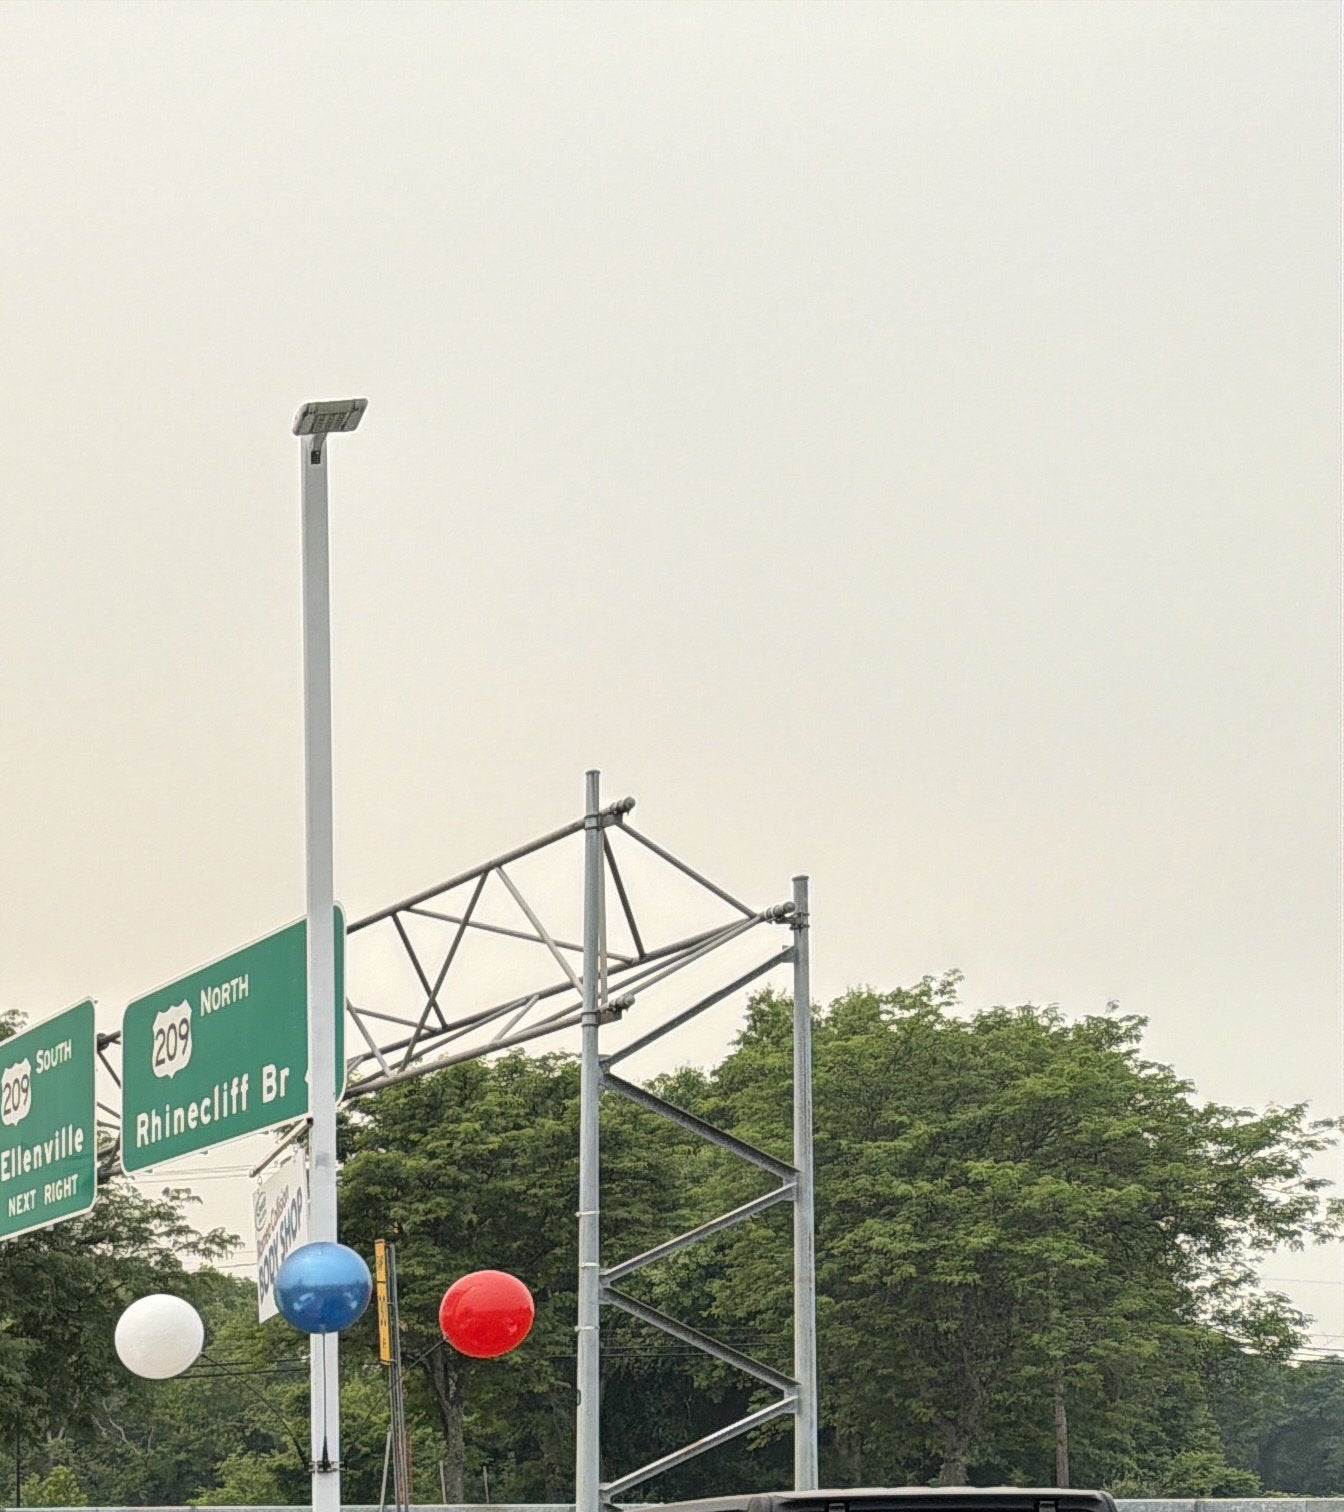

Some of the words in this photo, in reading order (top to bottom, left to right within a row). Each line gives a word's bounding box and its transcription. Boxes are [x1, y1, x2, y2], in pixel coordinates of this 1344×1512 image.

[200, 973, 249, 1017] NORTH
[35, 1039, 72, 1075] SOUTH
[155, 1018, 190, 1067] 209
[3, 1073, 29, 1116] 209
[136, 1073, 249, 1149] Rhinecliff
[262, 1063, 290, 1104] Br
[0, 1123, 84, 1182] Ellenville
[8, 1189, 37, 1218] NEXT
[44, 1173, 79, 1206] RIGHT
[279, 1186, 303, 1262] SHOP
